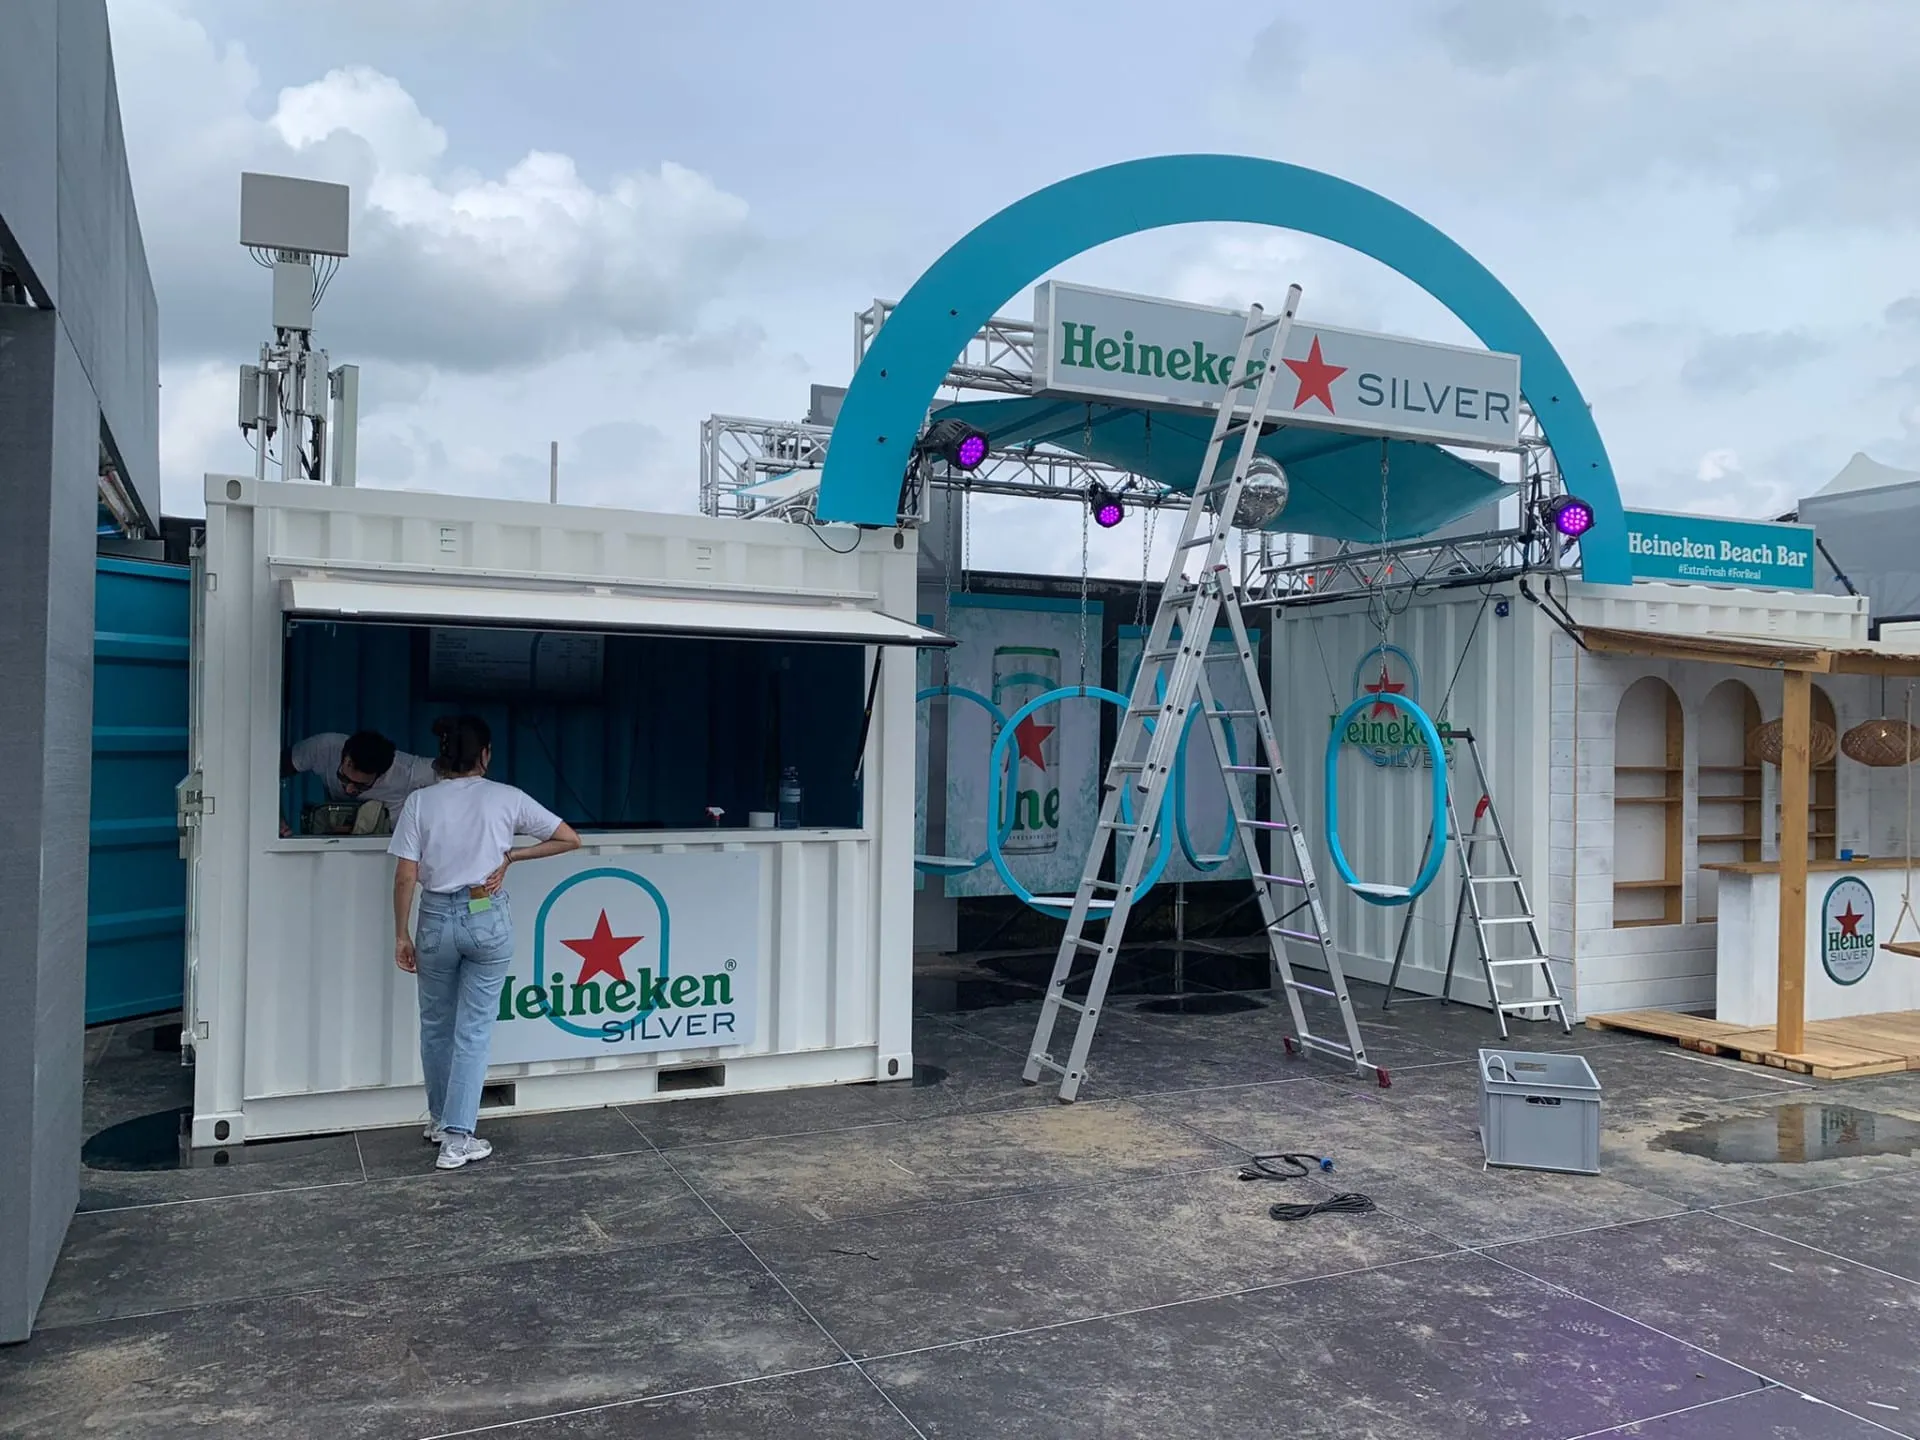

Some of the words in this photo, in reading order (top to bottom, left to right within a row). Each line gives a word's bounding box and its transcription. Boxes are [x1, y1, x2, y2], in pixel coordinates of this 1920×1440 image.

[1358, 373, 1511, 424] SILVER
[1628, 532, 1716, 560] Heineken
[1720, 540, 1773, 565] Beach
[1777, 545, 1807, 567] Bar
[1678, 563, 1726, 577] #ExtraFresh
[1728, 567, 1761, 580] #ForReal
[1830, 949, 1868, 961] SILVER
[602, 1012, 736, 1043] SILVER
